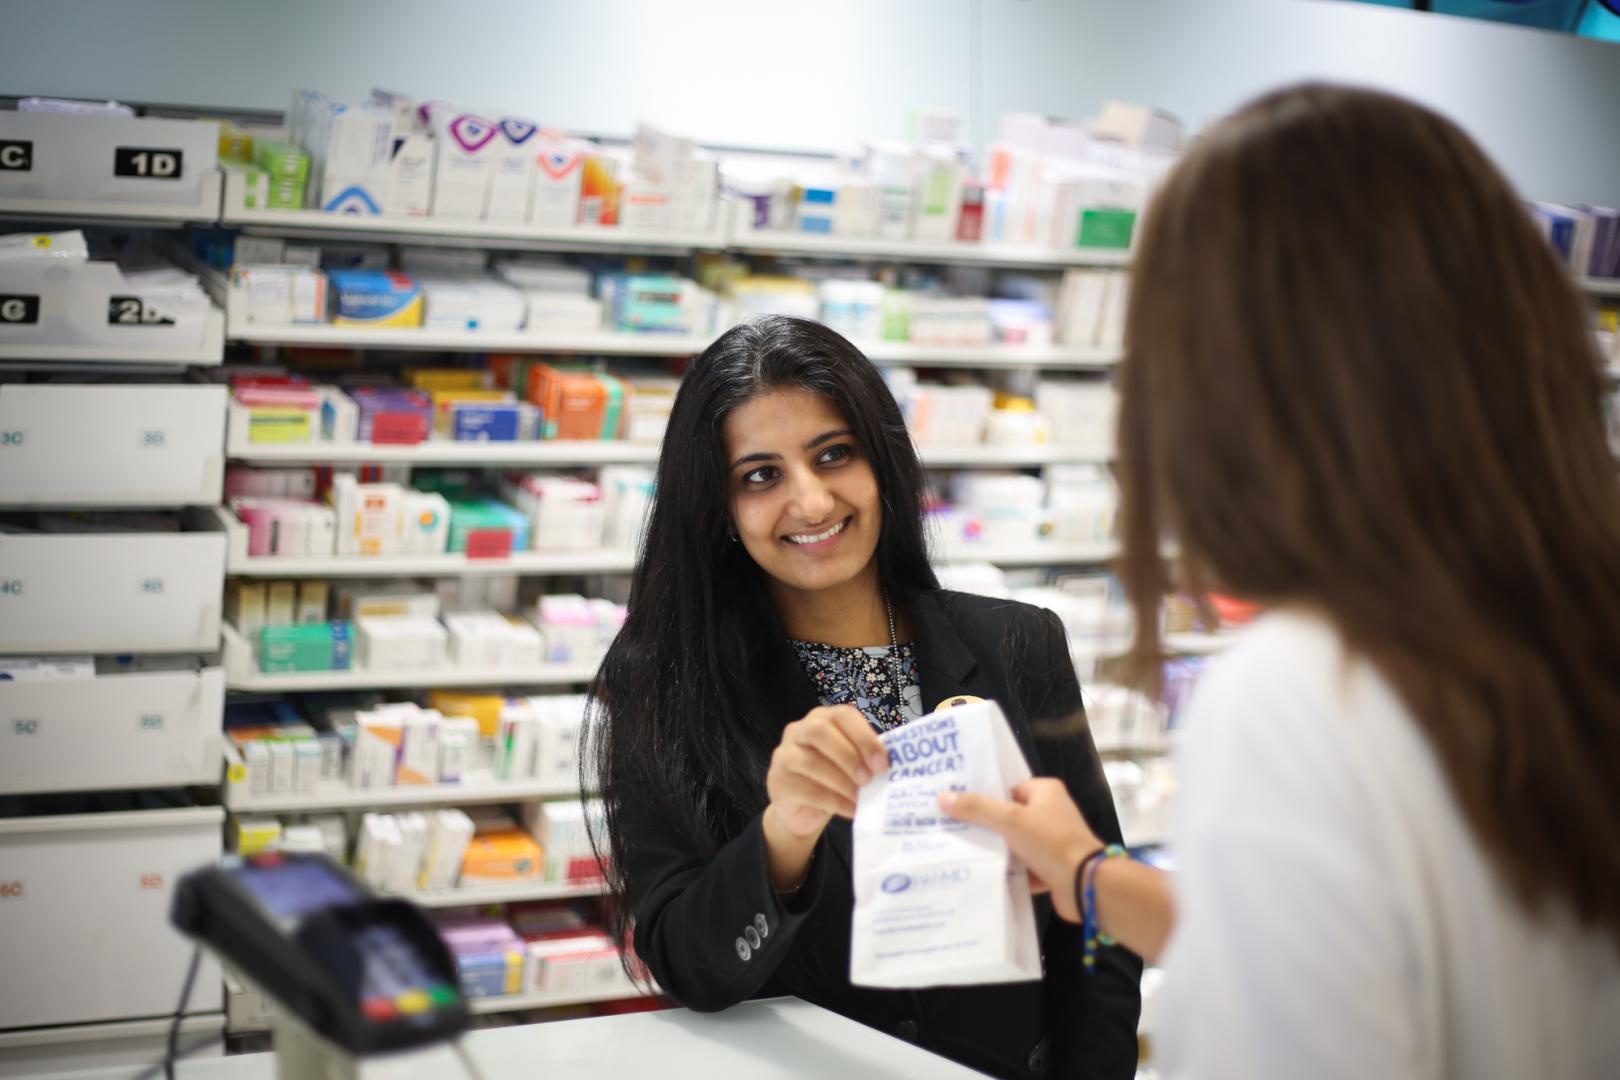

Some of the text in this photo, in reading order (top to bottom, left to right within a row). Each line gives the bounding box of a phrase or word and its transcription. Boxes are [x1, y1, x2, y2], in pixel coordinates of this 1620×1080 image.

[131, 153, 176, 176] 1D
[887, 731, 958, 768] ABOUT
[889, 753, 964, 782] CANCER?
